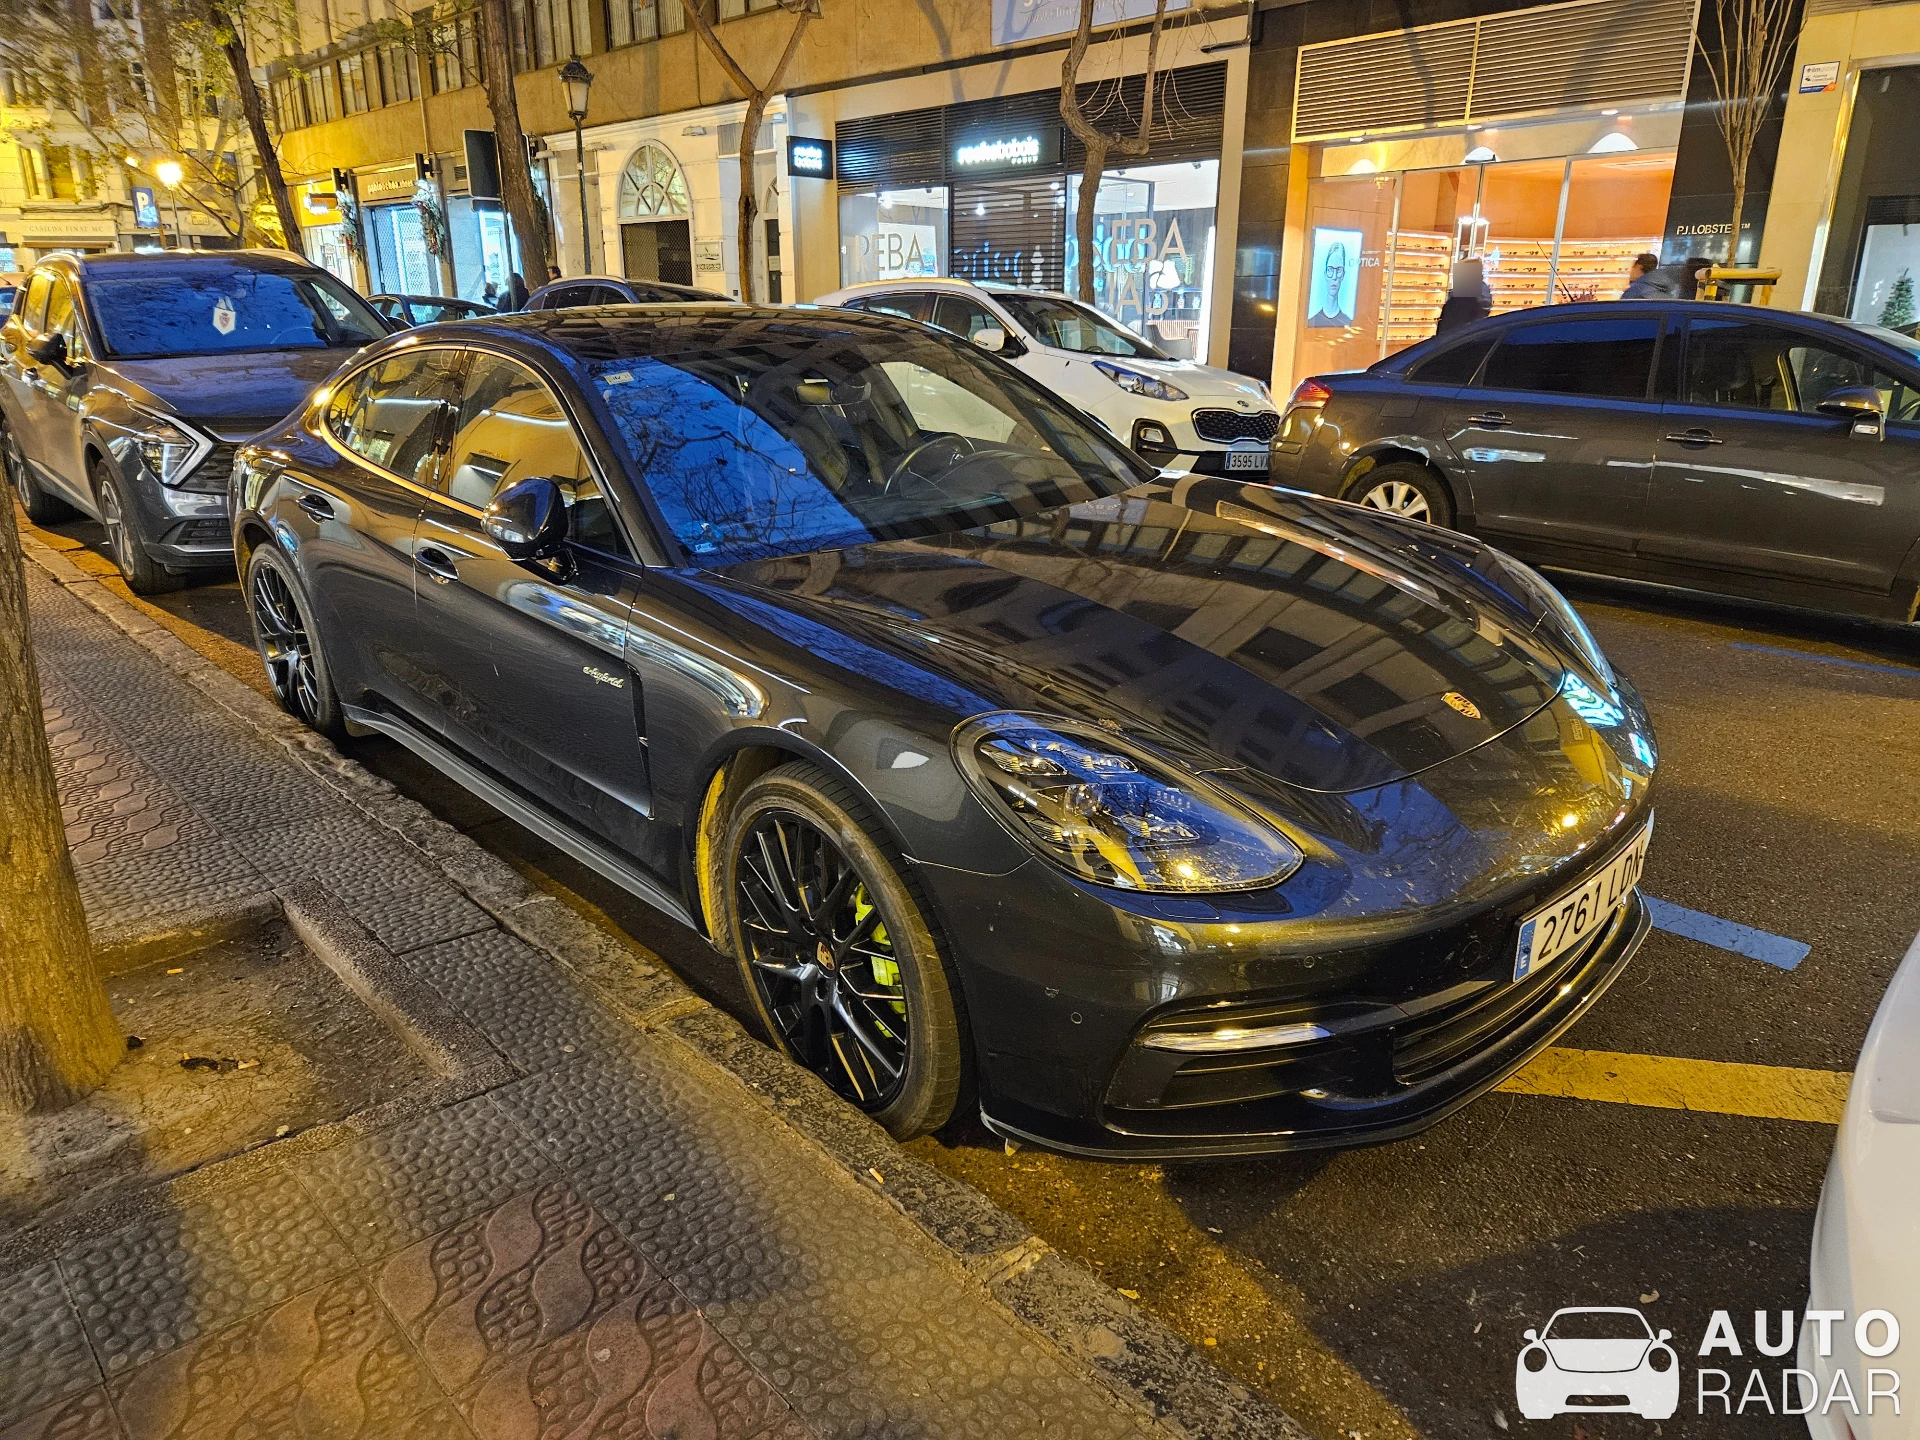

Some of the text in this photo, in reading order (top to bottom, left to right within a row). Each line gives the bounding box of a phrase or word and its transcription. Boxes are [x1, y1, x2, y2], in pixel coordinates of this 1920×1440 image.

[136, 191, 149, 212] P
[1231, 455, 1253, 468] 3595
[1538, 880, 1602, 961] 2761
